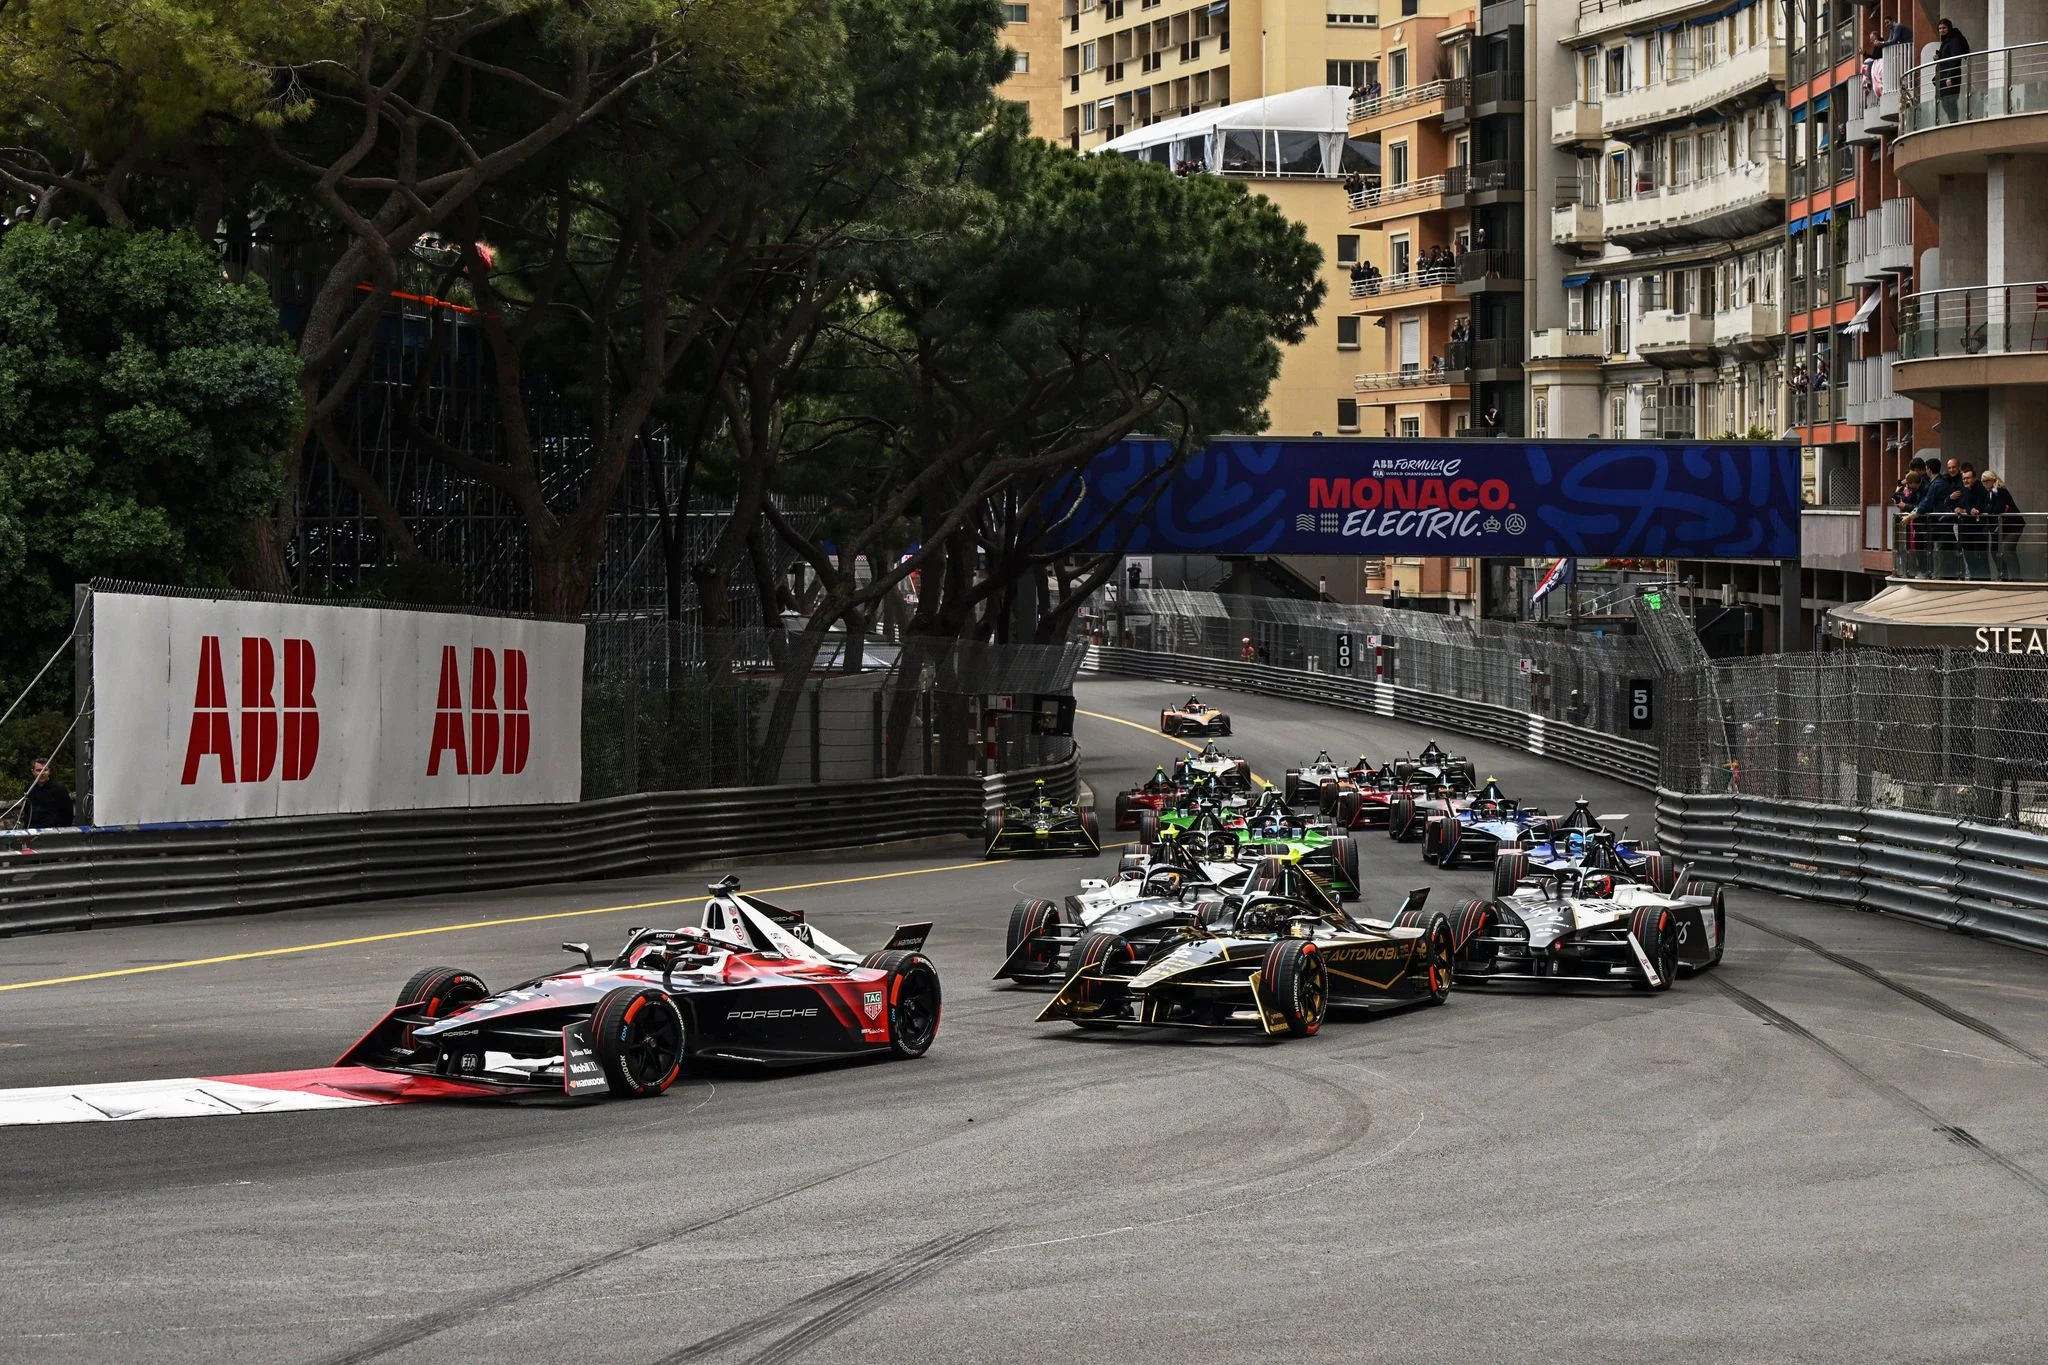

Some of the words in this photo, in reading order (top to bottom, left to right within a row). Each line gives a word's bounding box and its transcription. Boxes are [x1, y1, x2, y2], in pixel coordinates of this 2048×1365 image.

[1373, 460, 1393, 468] ABB
[1394, 459, 1444, 471] FORMULA
[1309, 478, 1516, 510] MONACO.
[1342, 508, 1482, 538] ELECTRIC.
[1975, 627, 2048, 655] STEA
[181, 635, 320, 785] ABB
[426, 645, 531, 777] ABB
[1633, 689, 1648, 719] 50
[865, 993, 881, 1003] TAG
[727, 1008, 818, 1020] PORSCHE
[865, 1003, 882, 1018] HEUER
[443, 1029, 479, 1037] PORSCHE
[570, 1062, 590, 1074] Mobil
